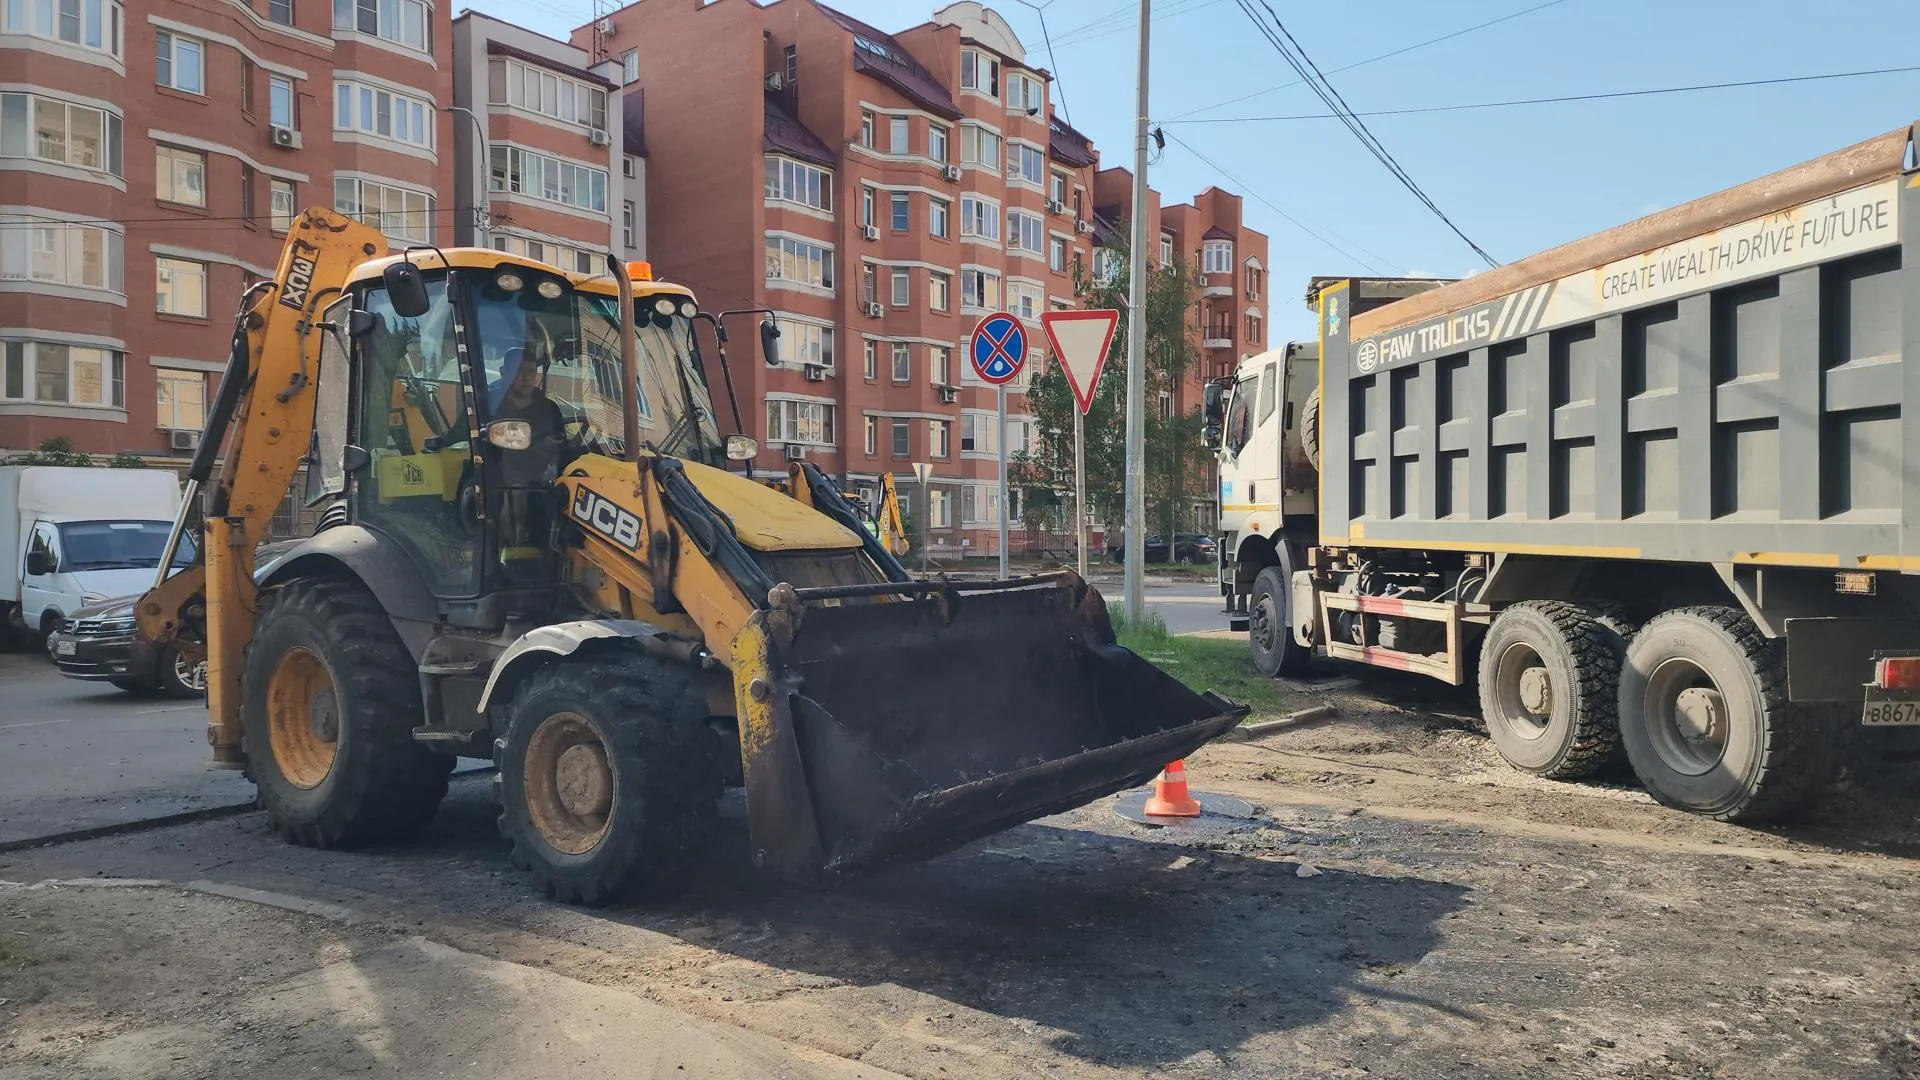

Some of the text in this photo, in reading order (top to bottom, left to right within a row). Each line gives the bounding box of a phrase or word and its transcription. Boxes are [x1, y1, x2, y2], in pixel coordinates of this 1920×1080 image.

[1602, 263, 1656, 299] CREATE
[1800, 200, 1889, 248] FUTURE
[281, 258, 313, 304] 3CX
[1380, 308, 1490, 364] FAW TRUCKS
[574, 493, 640, 548] JCB
